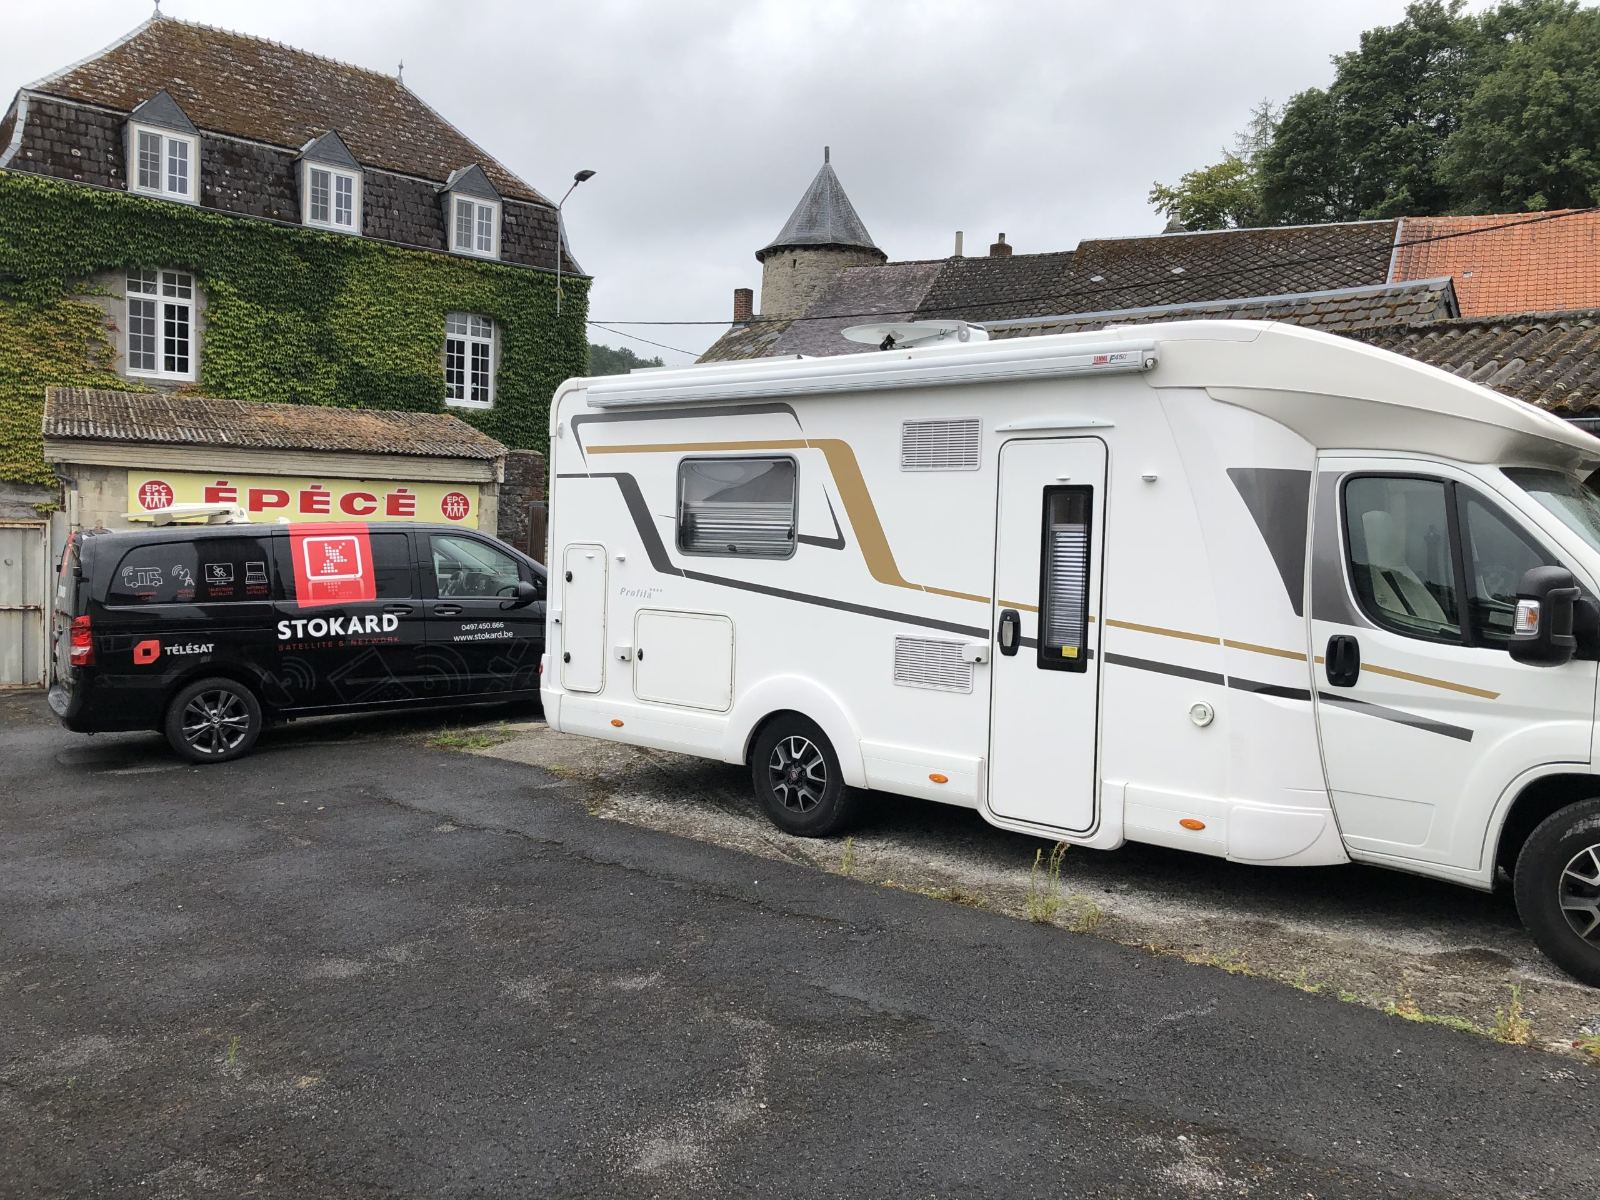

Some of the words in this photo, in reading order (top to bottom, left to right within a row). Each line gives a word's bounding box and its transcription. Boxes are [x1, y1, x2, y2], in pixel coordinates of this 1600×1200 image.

[145, 484, 168, 493] EPC
[204, 480, 416, 517] ÉPÉCÉ
[446, 495, 465, 503] EPC
[277, 613, 399, 640] STOKARD
[453, 630, 514, 642] www.stokard.be
[164, 642, 215, 656] TÉLÉSAT
[278, 640, 333, 652] SATELLITE
[350, 635, 400, 646] NETWORK
